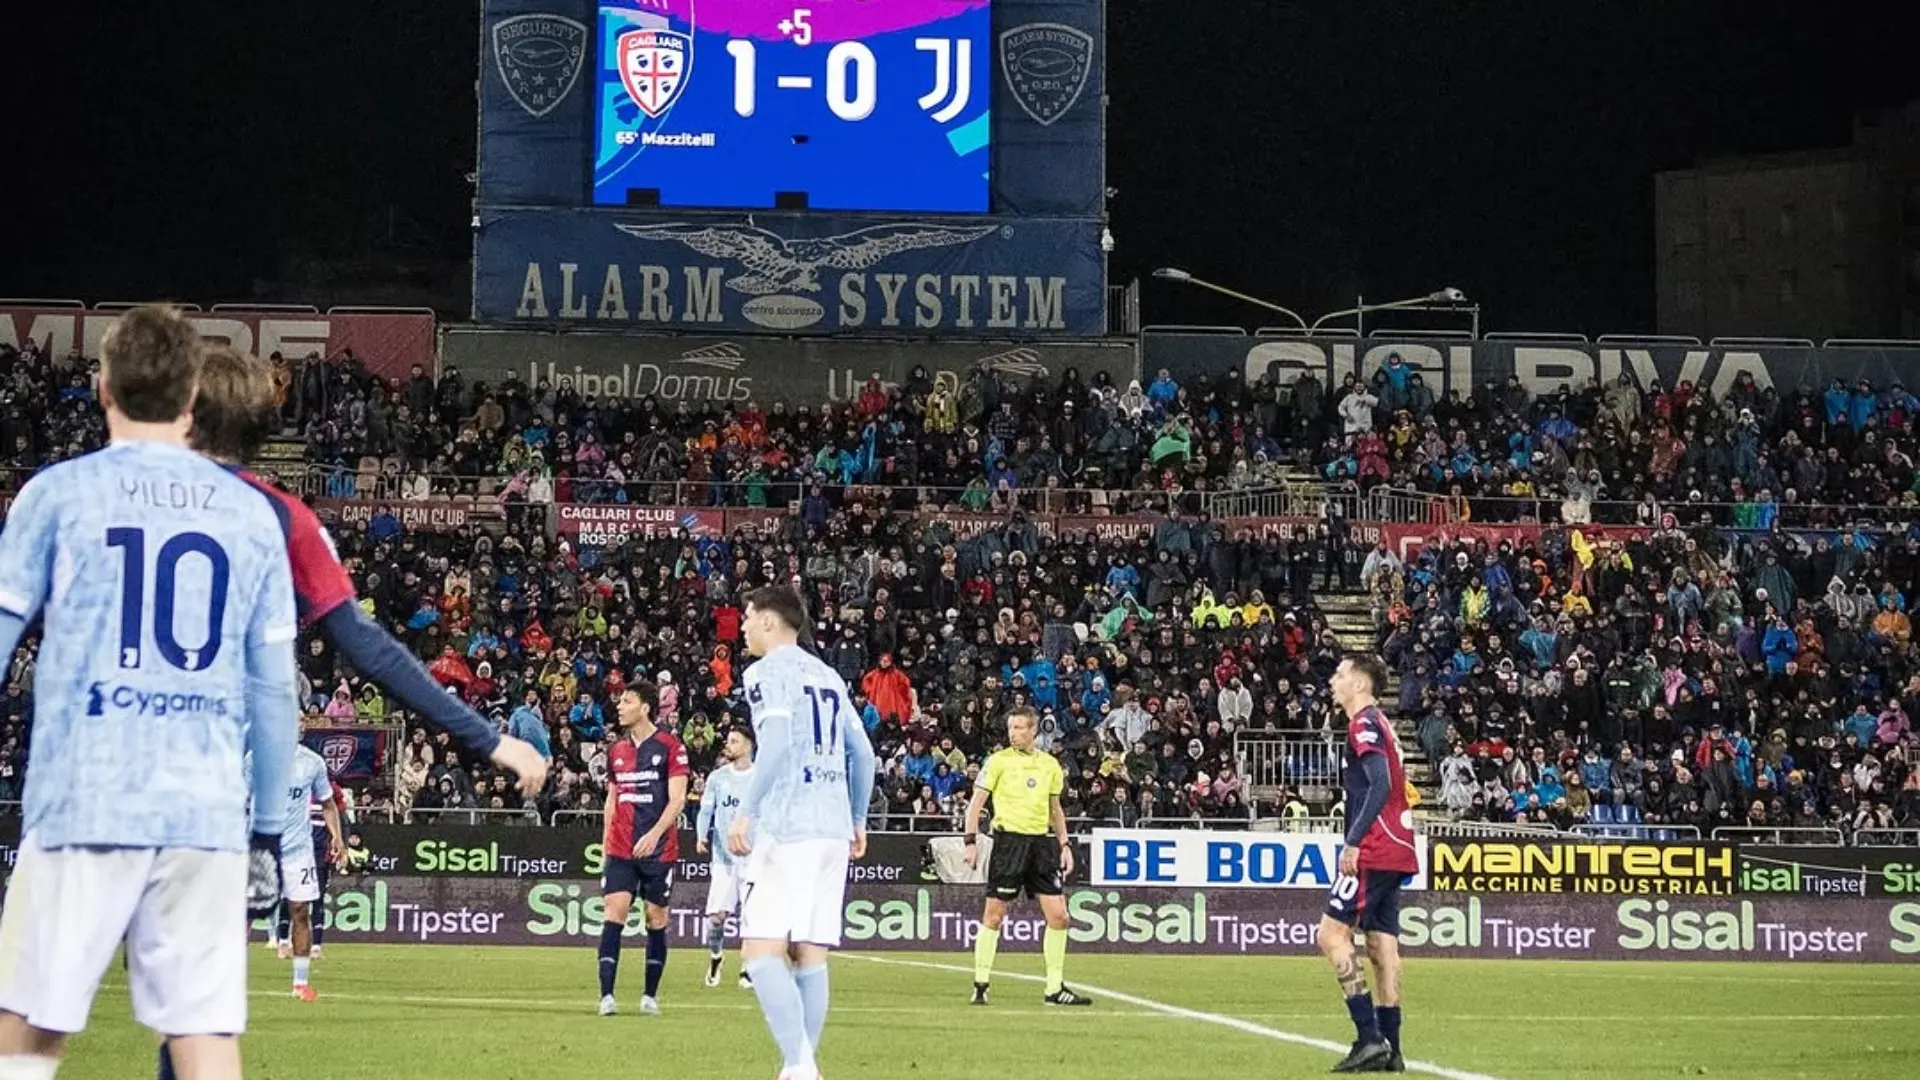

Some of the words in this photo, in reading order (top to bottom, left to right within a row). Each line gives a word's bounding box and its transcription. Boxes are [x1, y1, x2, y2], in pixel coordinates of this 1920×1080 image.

[500, 21, 579, 41] SECURITY
[628, 36, 684, 49] CAGLIARI
[777, 9, 812, 45] +5
[641, 132, 716, 147] Mazzitelli
[516, 262, 725, 323] ALARM
[838, 272, 1067, 329] SYSTEM
[119, 477, 218, 511] YILDIZ
[561, 506, 631, 520] CAGLIARI
[635, 508, 677, 521] CLUB
[106, 526, 230, 672] 10
[803, 685, 840, 756] 17
[721, 795, 741, 808] Je
[415, 840, 498, 872] Sisal
[500, 854, 567, 877] Tipster
[849, 861, 904, 882] ipster
[1103, 839, 1177, 882] BE
[1433, 875, 1563, 893] MACCHINE
[1574, 876, 1733, 896] INDUSTRIALI
[1739, 860, 1801, 894] isal
[390, 903, 505, 940] Tipster
[932, 911, 1047, 948] Tipter
[1067, 890, 1207, 944] Sisal
[1209, 915, 1321, 951] Tipster
[1484, 918, 1596, 955] Tipster
[1617, 899, 1755, 951] Sisal
[1757, 923, 1868, 959] Tipster
